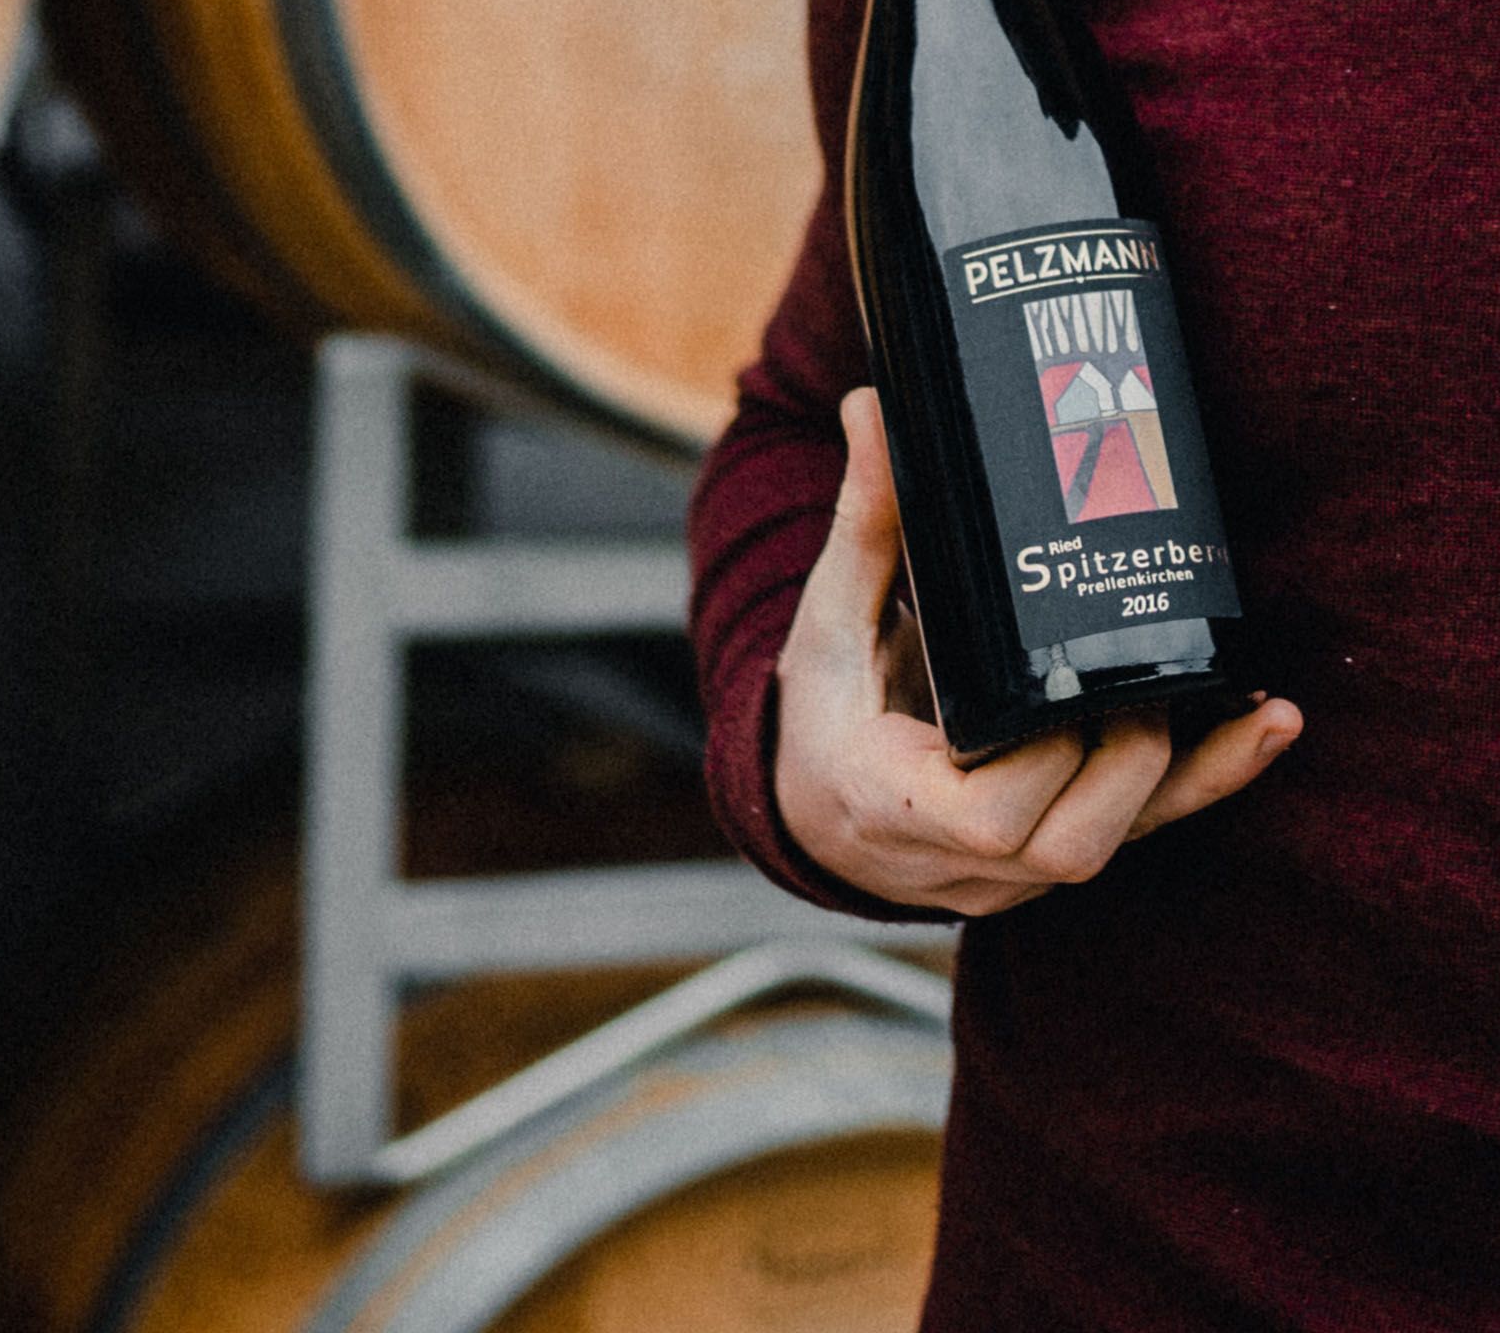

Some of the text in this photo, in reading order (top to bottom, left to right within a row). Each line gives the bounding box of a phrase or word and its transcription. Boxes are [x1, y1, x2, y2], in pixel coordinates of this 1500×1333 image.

[964, 239, 1160, 296] PELZMANN
[1049, 536, 1083, 556] Ried
[1077, 569, 1194, 596] Prellenkirchen
[1121, 592, 1170, 617] 2016
